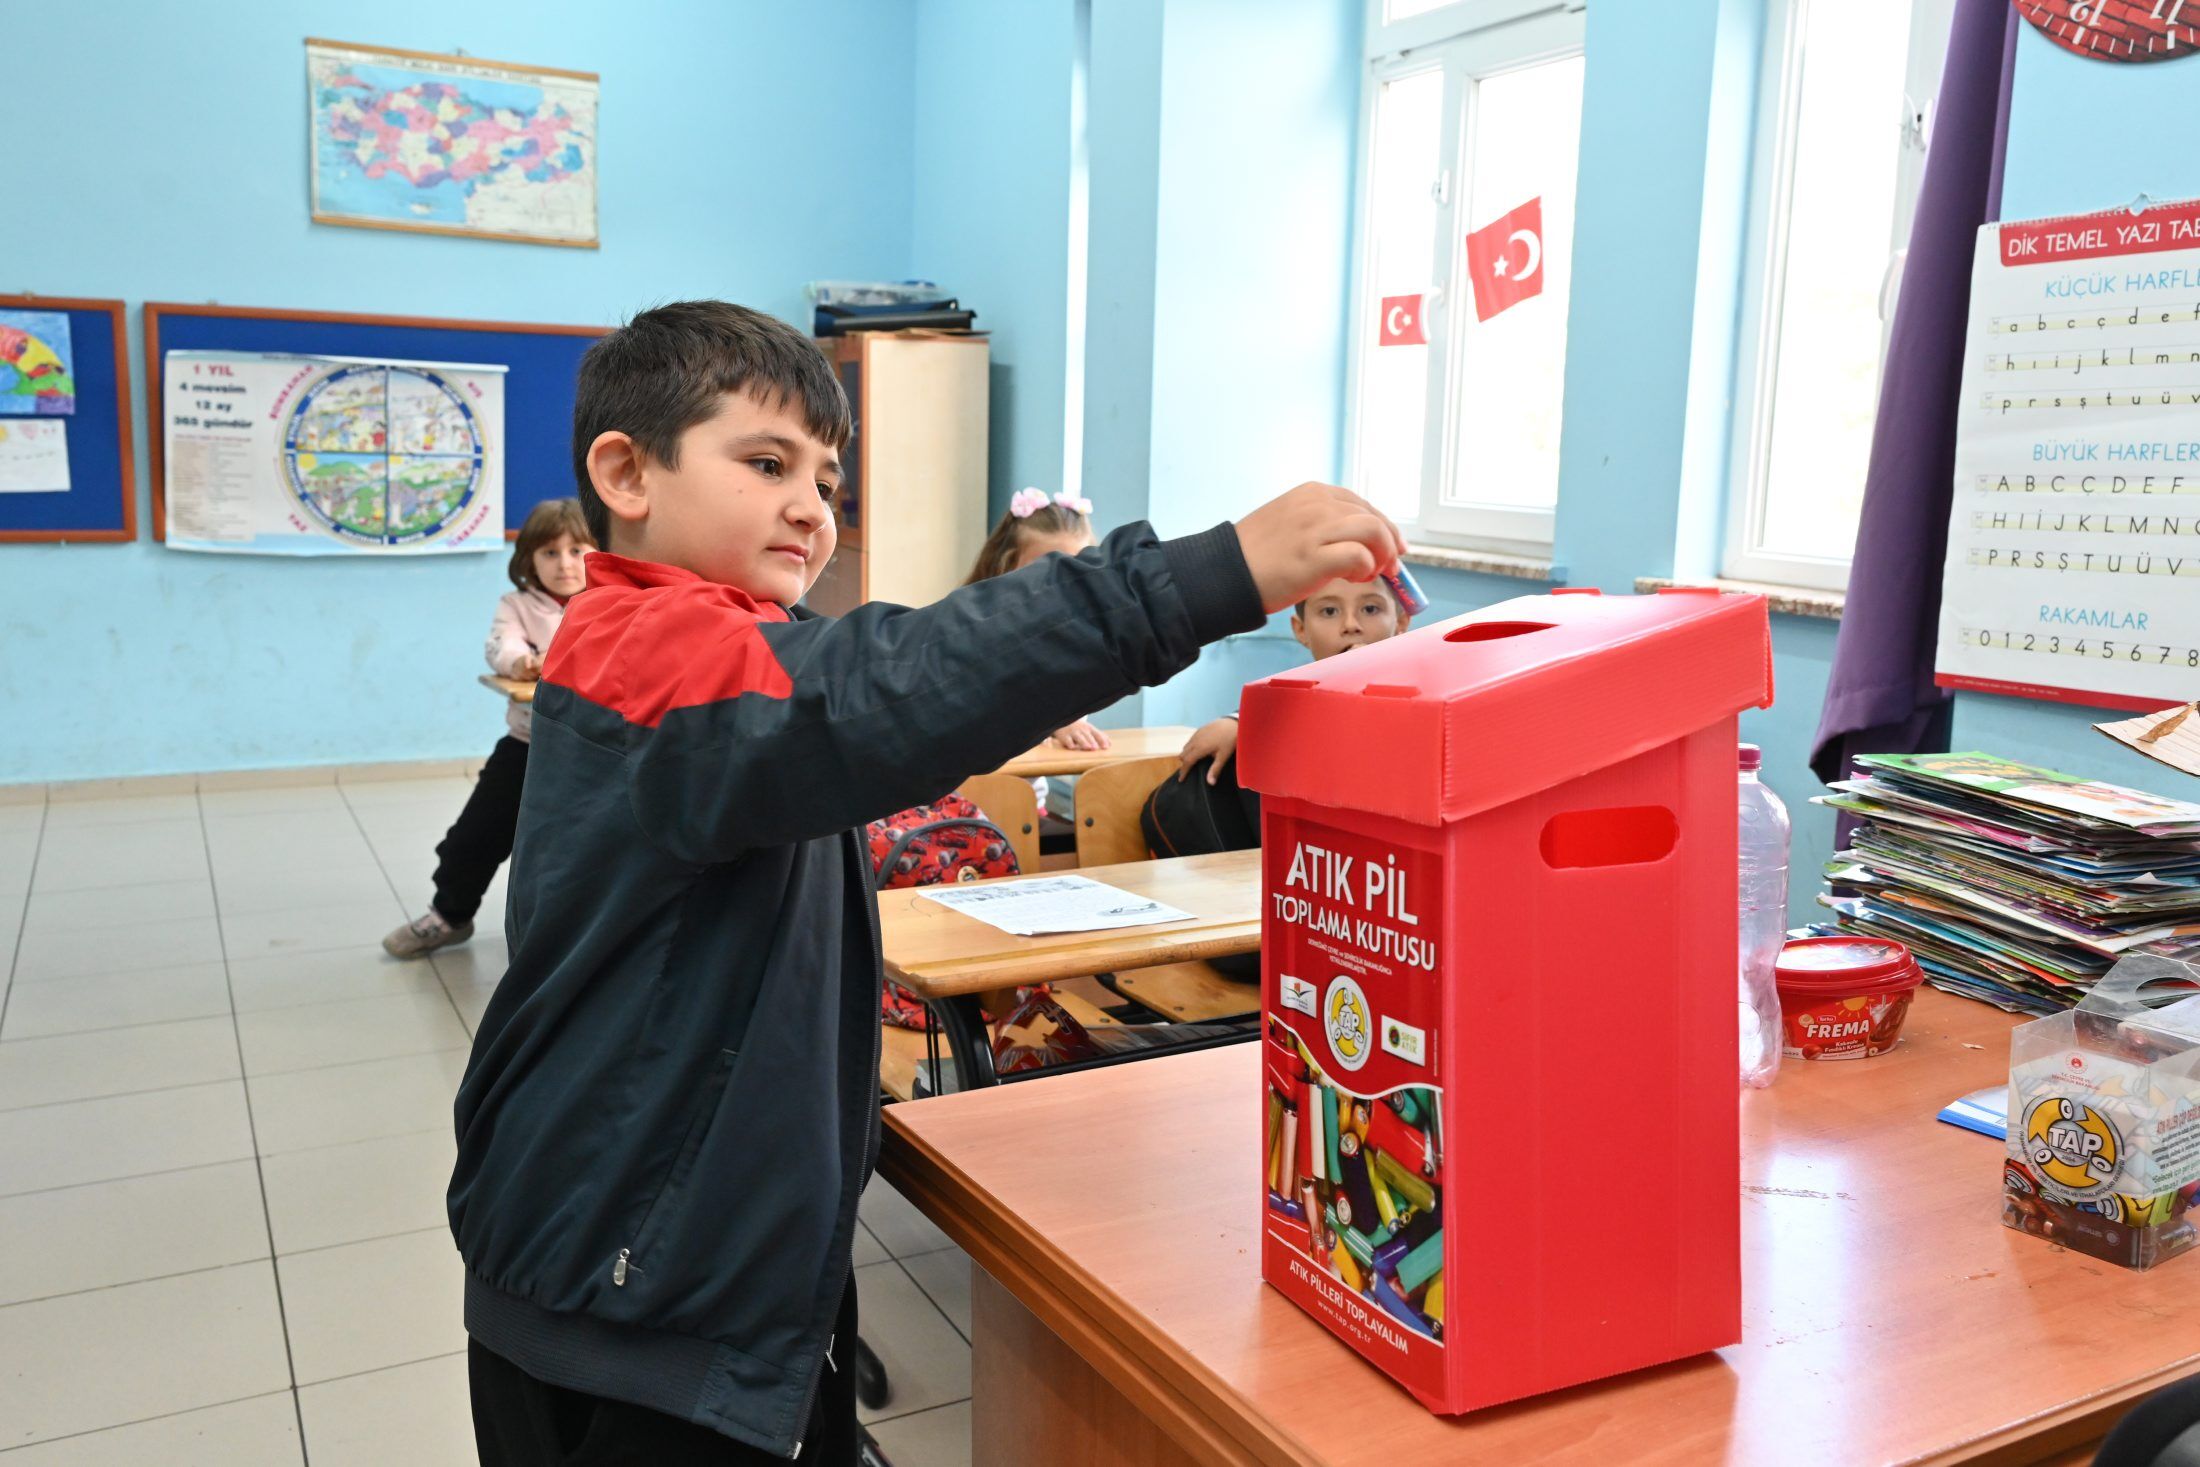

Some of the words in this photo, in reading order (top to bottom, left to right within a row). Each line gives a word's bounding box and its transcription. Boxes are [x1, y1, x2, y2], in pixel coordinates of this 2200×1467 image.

[2008, 233, 2037, 257] DİK
[2045, 229, 2108, 253] TEMEL
[2116, 222, 2160, 245] YAZI
[2045, 275, 2116, 298] KÜÇÜK
[2009, 323, 2019, 333] a
[2037, 313, 2047, 331] b
[2066, 319, 2076, 329] c
[2096, 317, 2106, 330] ç
[2128, 306, 2139, 325] d
[2160, 313, 2170, 323] e
[208, 364, 234, 376] YIL
[2005, 353, 2015, 371] h
[2073, 354, 2082, 375] j
[2101, 348, 2109, 366] k
[2155, 354, 2170, 364] m
[2190, 352, 2200, 363] n
[2002, 399, 2012, 415] p
[2028, 398, 2037, 408] r
[2054, 397, 2062, 408] s
[2079, 397, 2087, 410] ş
[2106, 392, 2112, 406] t
[2131, 395, 2141, 406] u
[2161, 391, 2171, 405] ü
[2032, 438, 2099, 461] BÜYÜK
[2107, 442, 2200, 462] HARFLER
[1996, 475, 2010, 492] A
[2025, 474, 2036, 493] B
[2050, 475, 2066, 493] C
[2081, 475, 2096, 497] Ç
[2111, 475, 2127, 494] D
[2142, 475, 2156, 494] E
[2171, 476, 2185, 494] F
[1991, 512, 2007, 529] H
[2036, 508, 2043, 531] İ
[2053, 514, 2065, 532] J
[2078, 514, 2092, 532] K
[2103, 514, 2115, 534] L
[2129, 516, 2149, 534] M
[2163, 516, 2180, 535] N
[1988, 548, 1999, 566] P
[2010, 549, 2021, 567] R
[2033, 551, 2045, 569] S
[2057, 552, 2069, 573] Ş
[2083, 553, 2095, 572] T
[2107, 554, 2122, 573] U
[2136, 551, 2151, 575] Ü
[2167, 557, 2183, 576] V
[2039, 604, 2149, 631] RAKAMLAR
[1979, 629, 1991, 647] 0
[2023, 633, 2036, 652] 2
[2049, 635, 2060, 654] 3
[2074, 639, 2086, 656] 4
[2102, 640, 2115, 659] 5
[2130, 644, 2142, 662] 6
[2159, 646, 2171, 664] 7
[2187, 649, 2200, 668] 8
[1285, 841, 1354, 905] ATIK
[1365, 853, 1418, 925] PİL
[1272, 892, 1352, 944] TOPLAMA
[1356, 918, 1435, 971] KUTUSU
[1338, 1007, 1361, 1032] TAP
[1807, 1019, 1870, 1038] FREMA
[2049, 1127, 2104, 1158] TAP
[1289, 1259, 1309, 1283] ATIK
[1310, 1274, 1343, 1308] PİLLERİ
[1345, 1299, 1409, 1354] TOPLAYALIM
[1317, 1301, 1372, 1344] www.tap.org.tr
